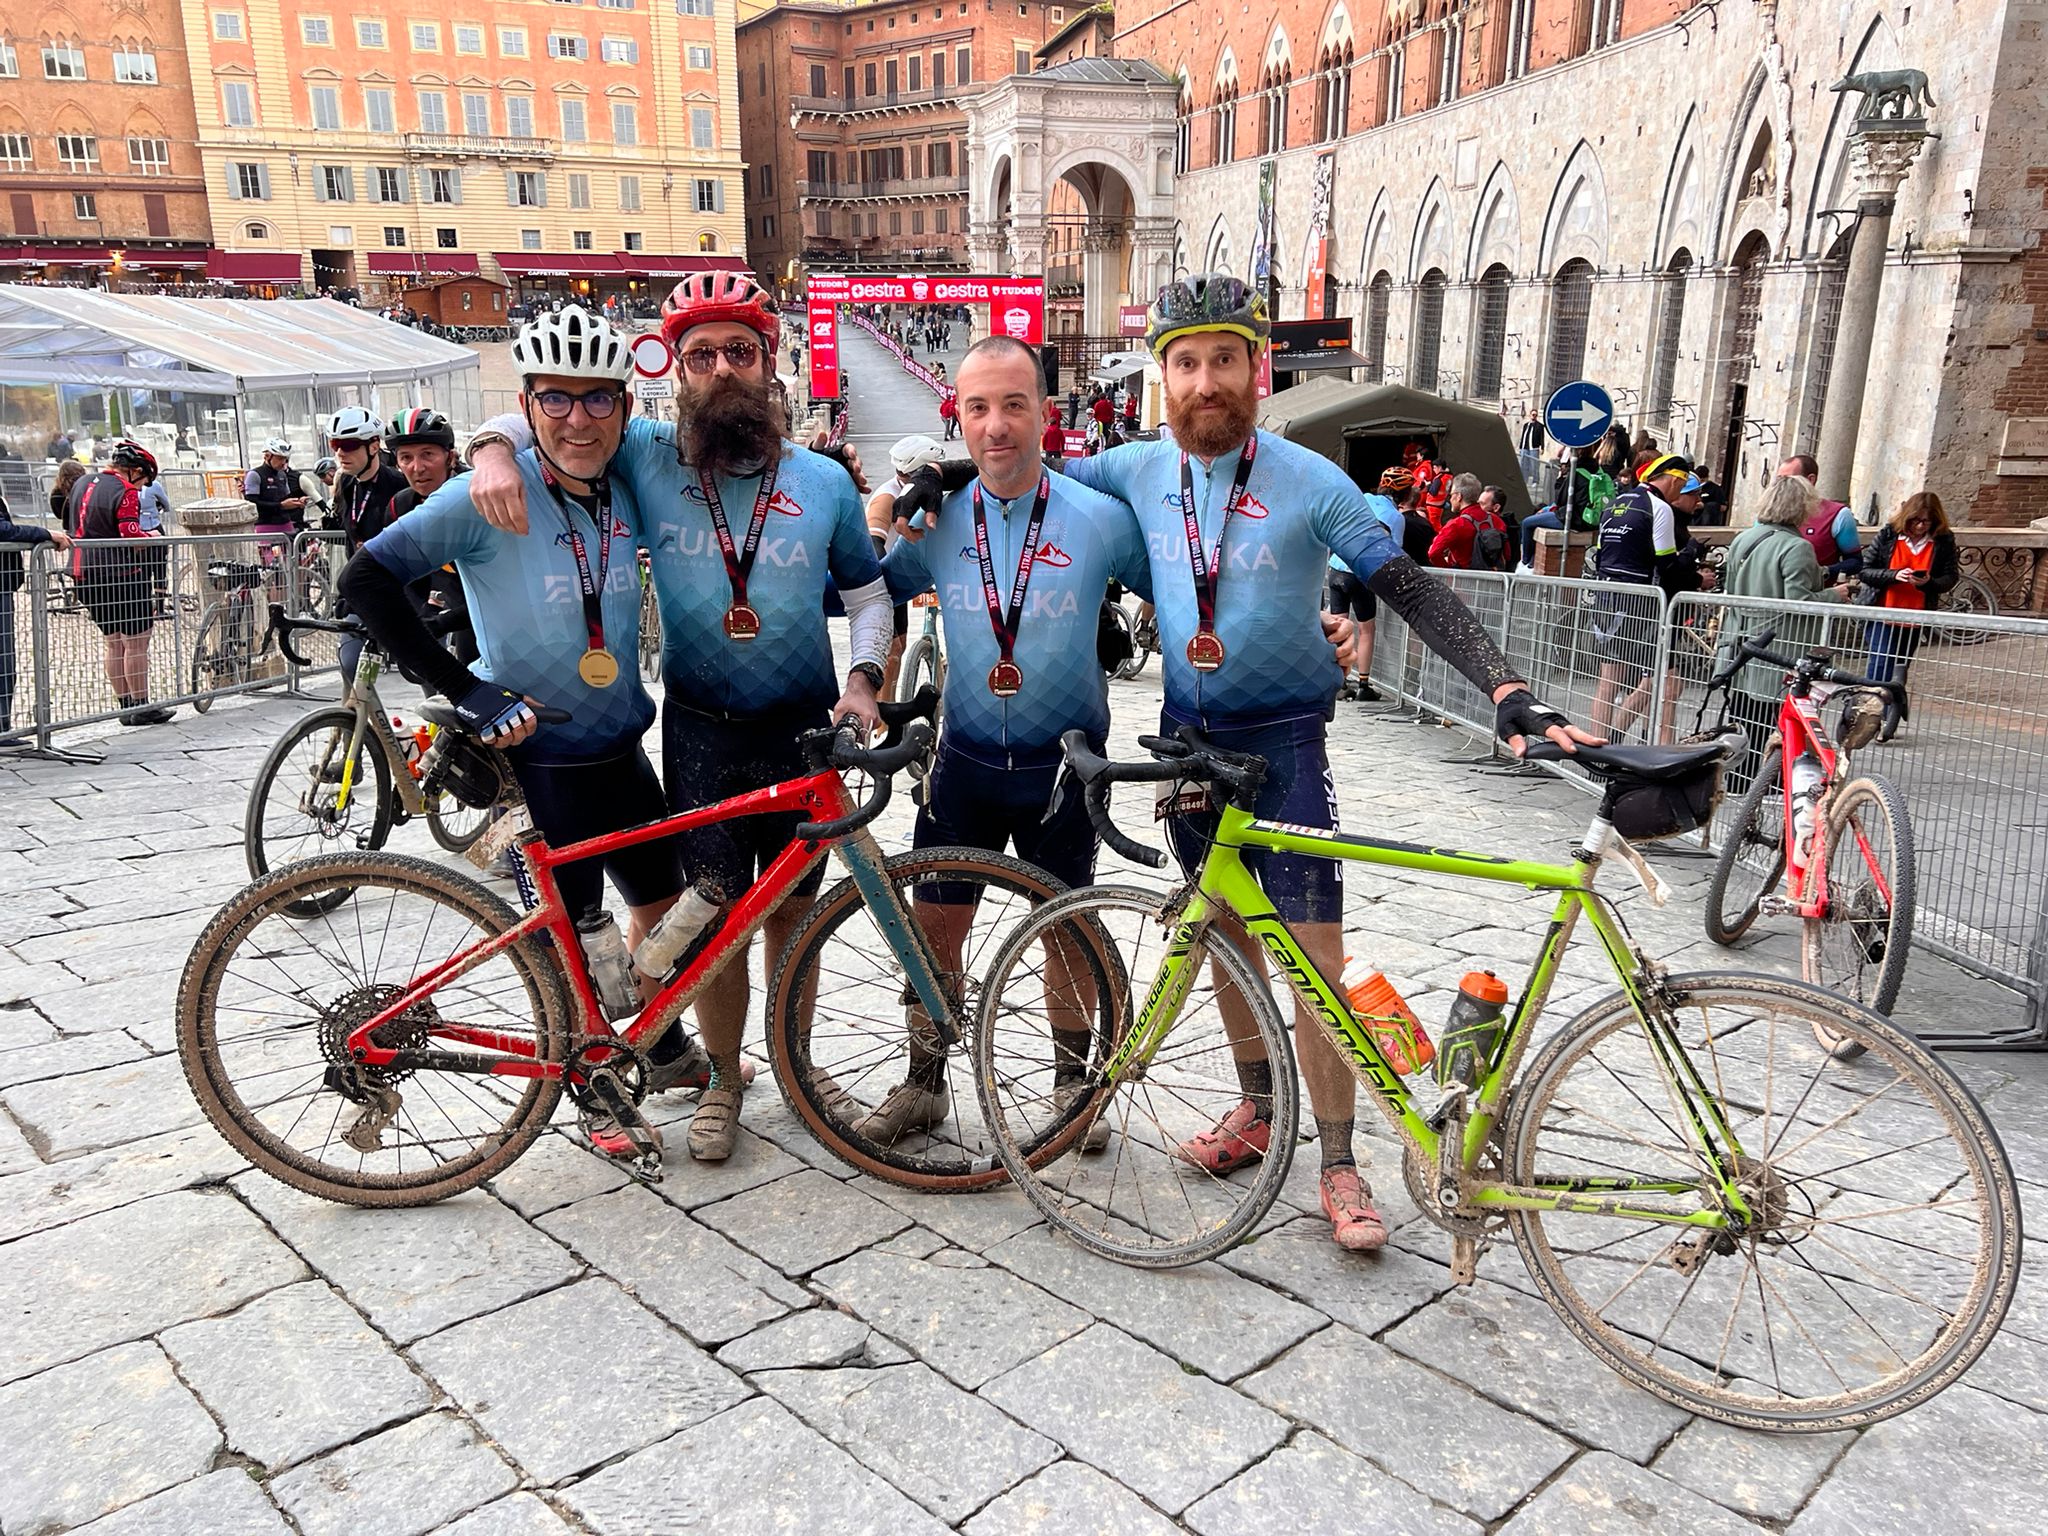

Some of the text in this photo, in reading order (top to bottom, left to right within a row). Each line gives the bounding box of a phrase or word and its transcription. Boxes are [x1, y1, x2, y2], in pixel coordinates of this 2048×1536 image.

[815, 280, 843, 288] TUDOR
[864, 282, 906, 298] estra
[948, 282, 989, 298] estra
[1001, 286, 1035, 295] TUDOR
[756, 493, 769, 517] STRADE
[1230, 484, 1244, 510] BIANCHE
[711, 503, 725, 527] STRADE
[719, 527, 733, 552] BIANCHE
[750, 516, 763, 536] FONDO
[1183, 487, 1205, 576] GRAN FONDO STRADE BIANCHE
[745, 535, 759, 552] GRAN
[979, 539, 989, 560] FONDO
[579, 556, 590, 577] FONDO
[981, 560, 993, 583] STRADE
[1012, 522, 1040, 607] GRAN FONDO STRADE BIANCHE
[582, 577, 594, 595] GRAN
[985, 583, 998, 608] BIANCHE
[1114, 964, 1172, 1066] cannondale
[1261, 932, 1406, 1117] cannondale
